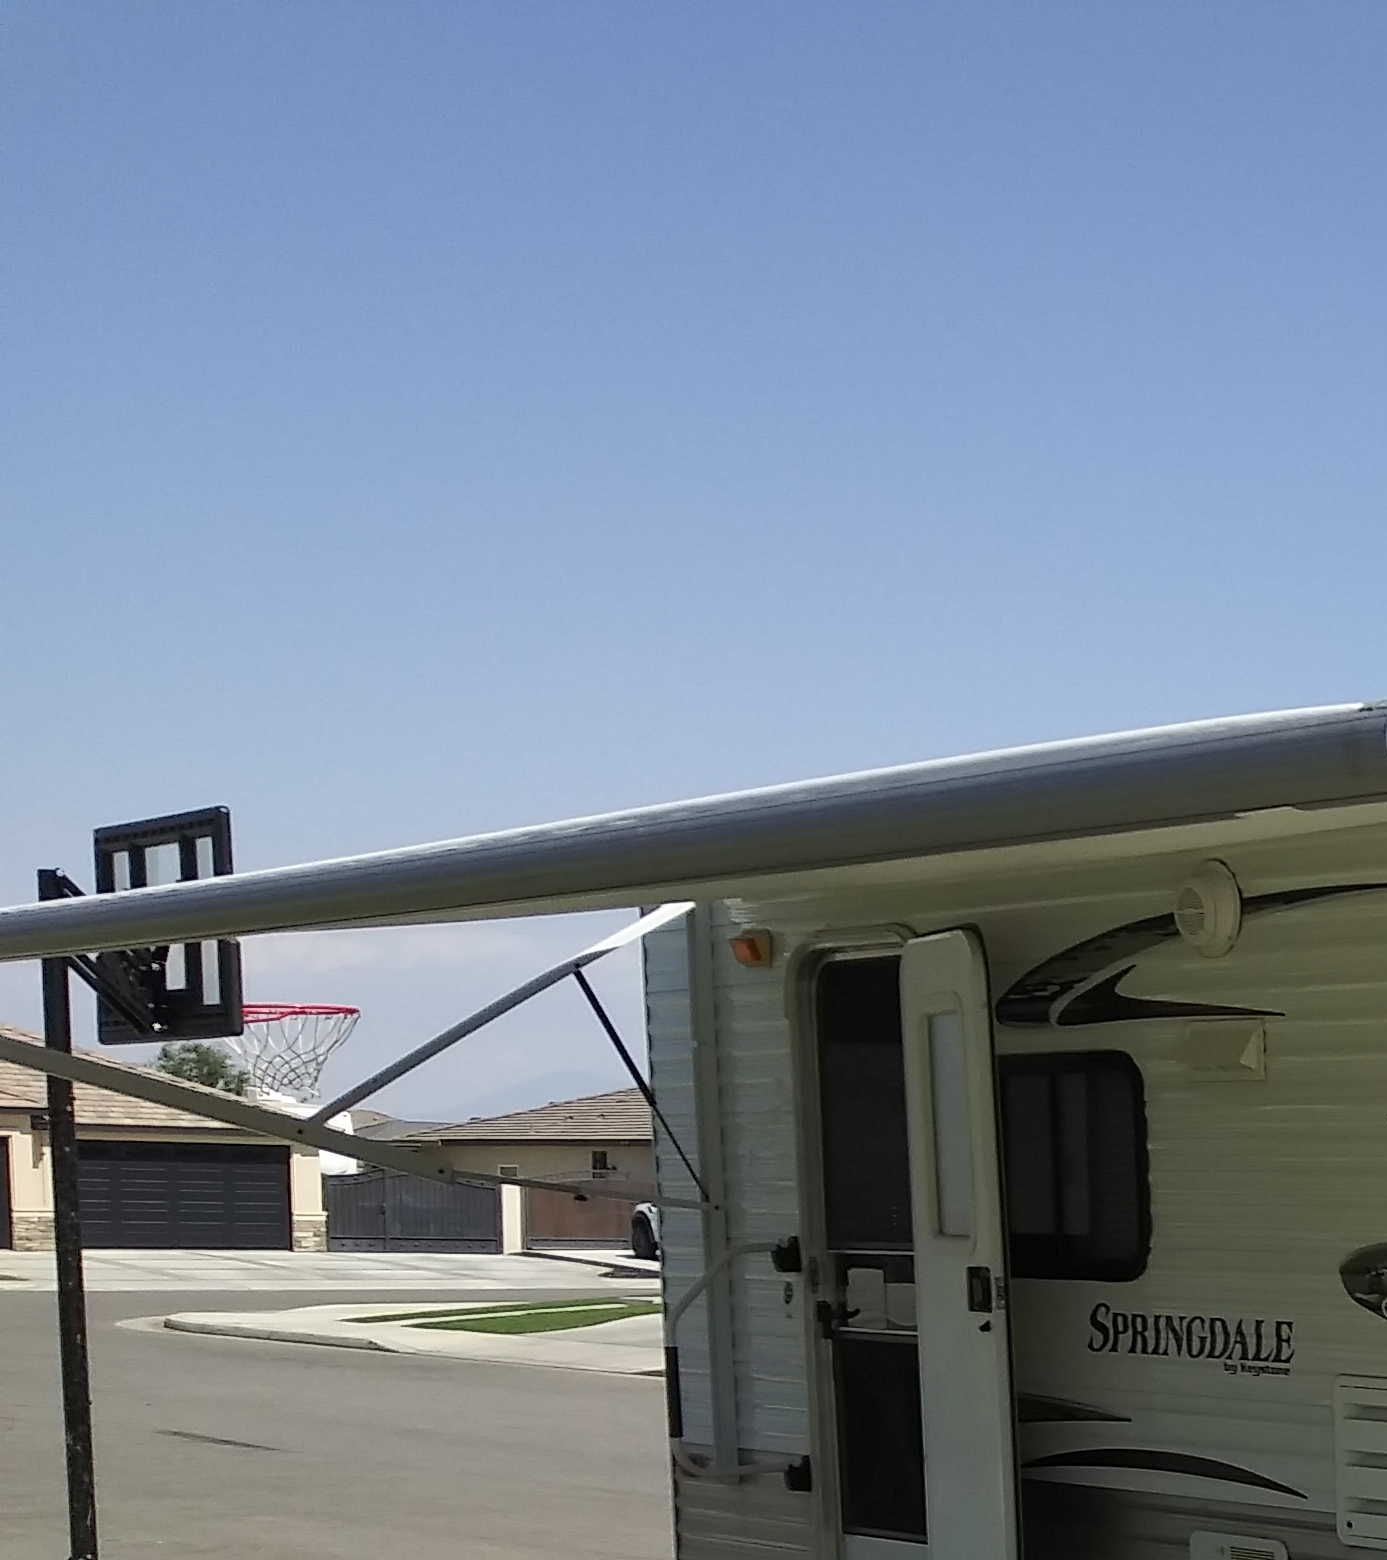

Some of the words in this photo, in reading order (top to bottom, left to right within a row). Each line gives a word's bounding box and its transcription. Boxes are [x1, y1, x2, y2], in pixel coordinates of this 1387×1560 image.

[1088, 1302, 1295, 1363] SPRINGDALE
[1224, 1362, 1238, 1375] by
[1240, 1362, 1291, 1377] Keystone
